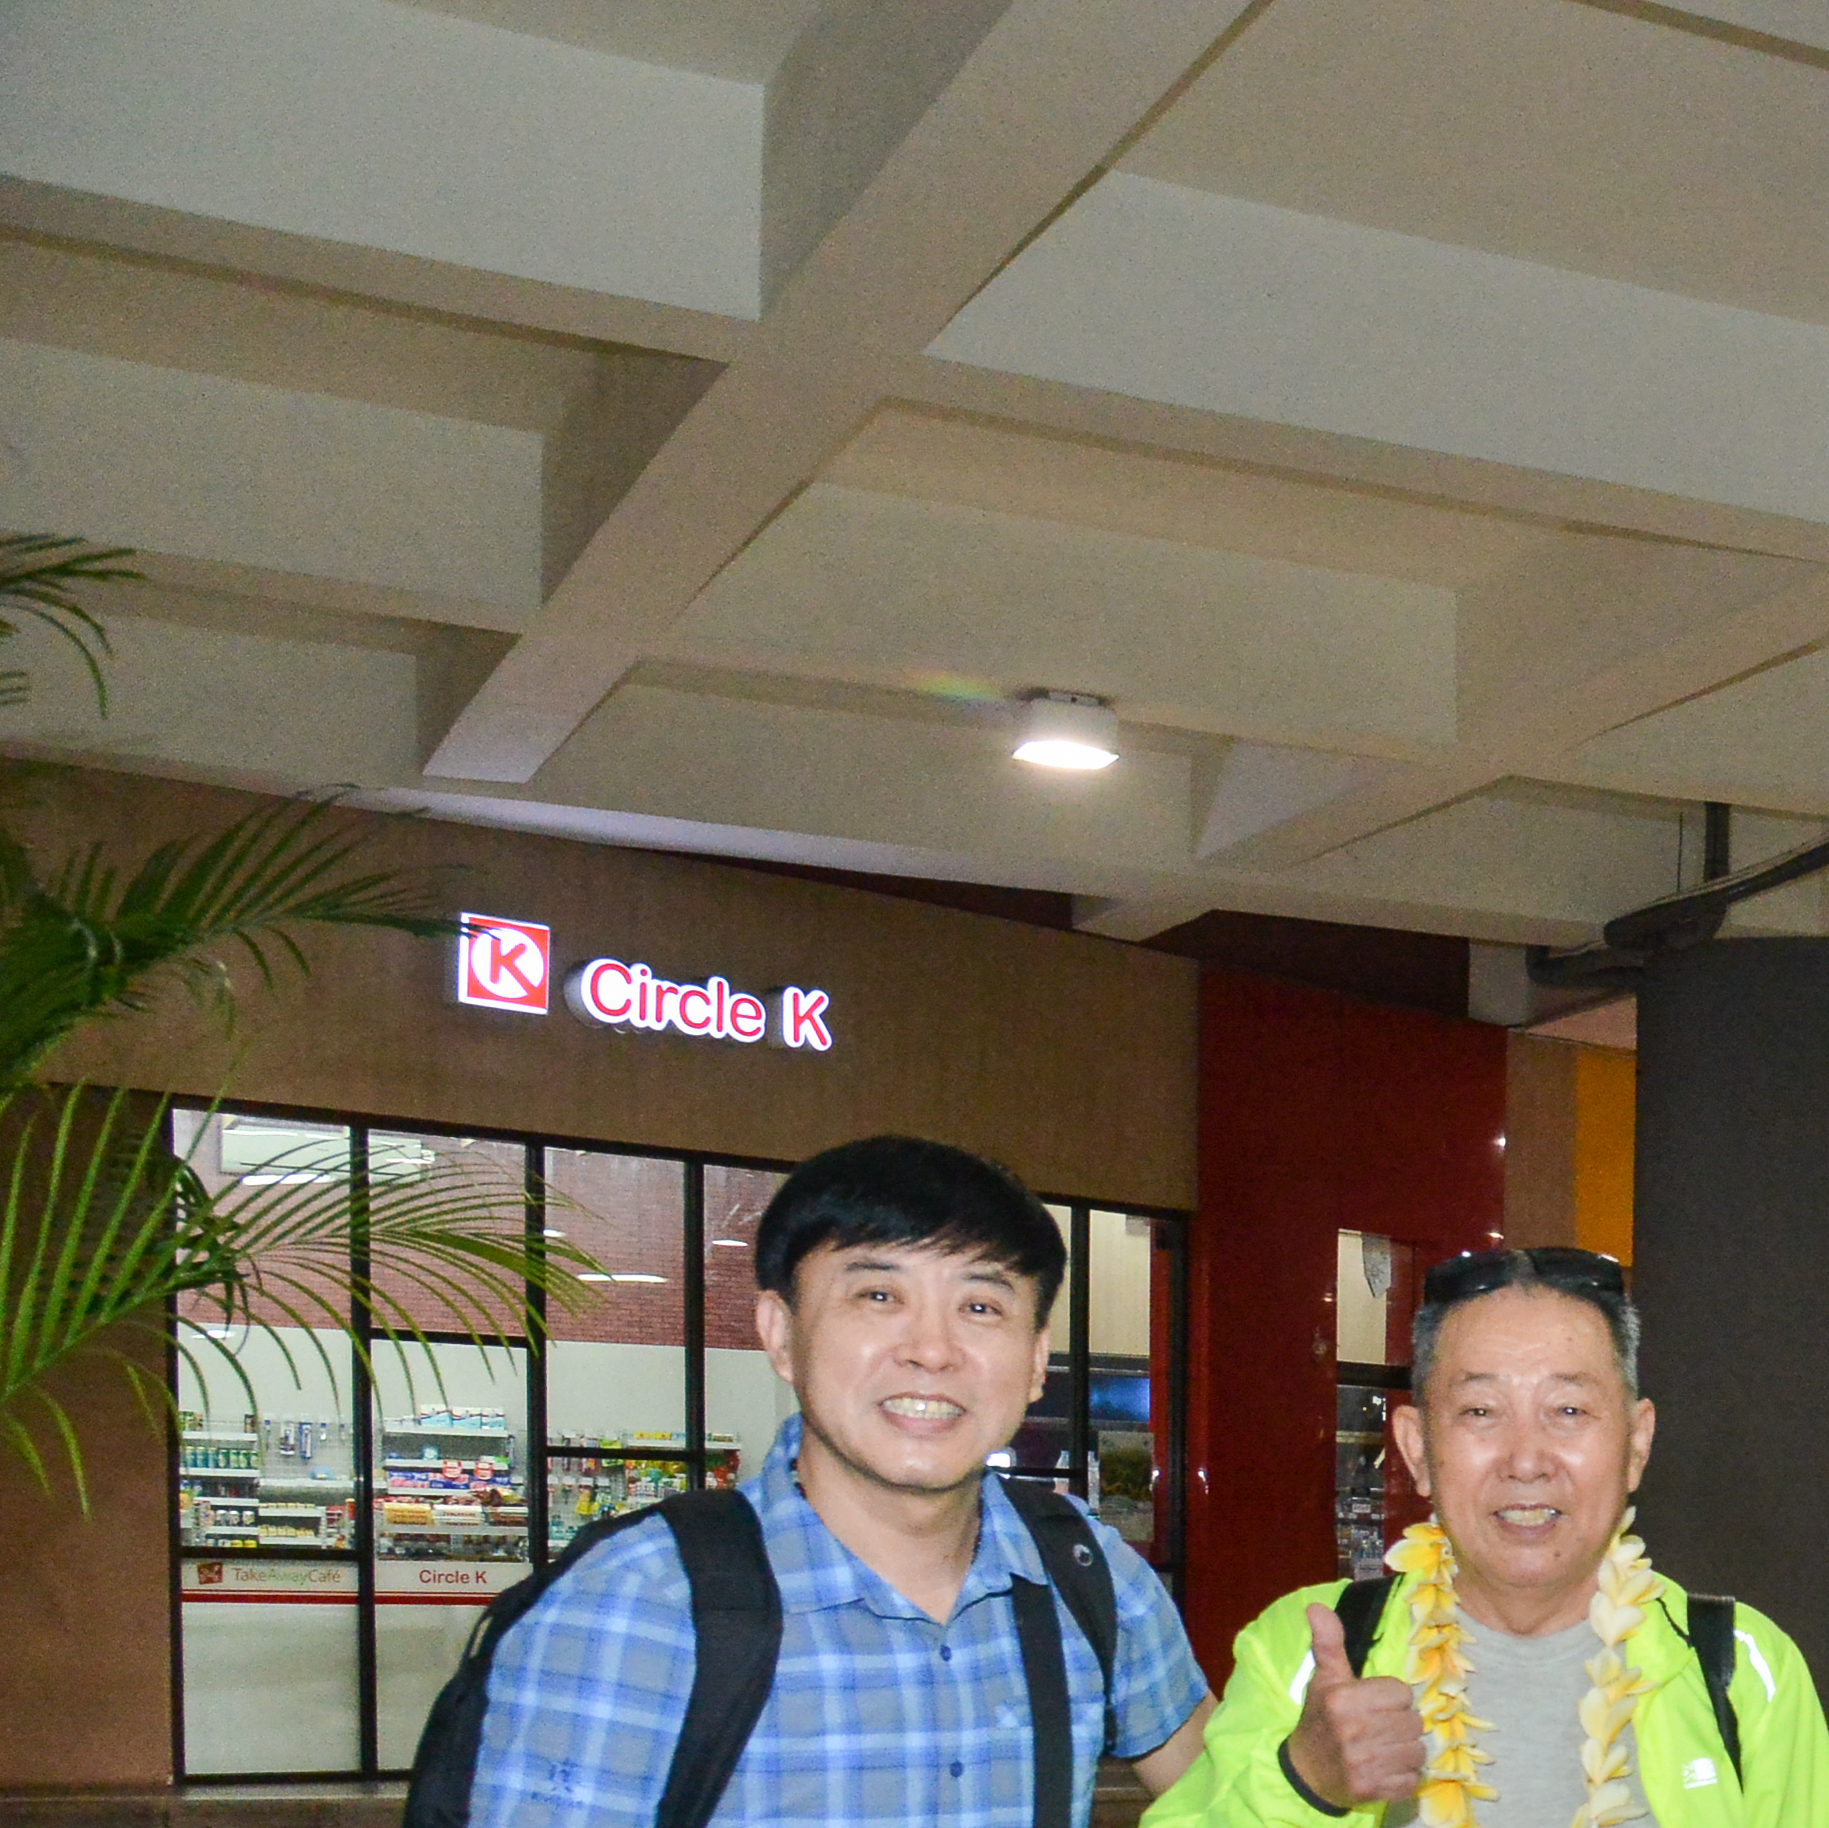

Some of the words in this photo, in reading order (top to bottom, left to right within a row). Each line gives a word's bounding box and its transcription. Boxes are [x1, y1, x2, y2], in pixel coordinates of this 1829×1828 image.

[488, 937, 541, 1002] K
[584, 959, 764, 1041] Circle
[785, 988, 831, 1050] K
[419, 1569, 470, 1584] Circle
[475, 1570, 487, 1584] K
